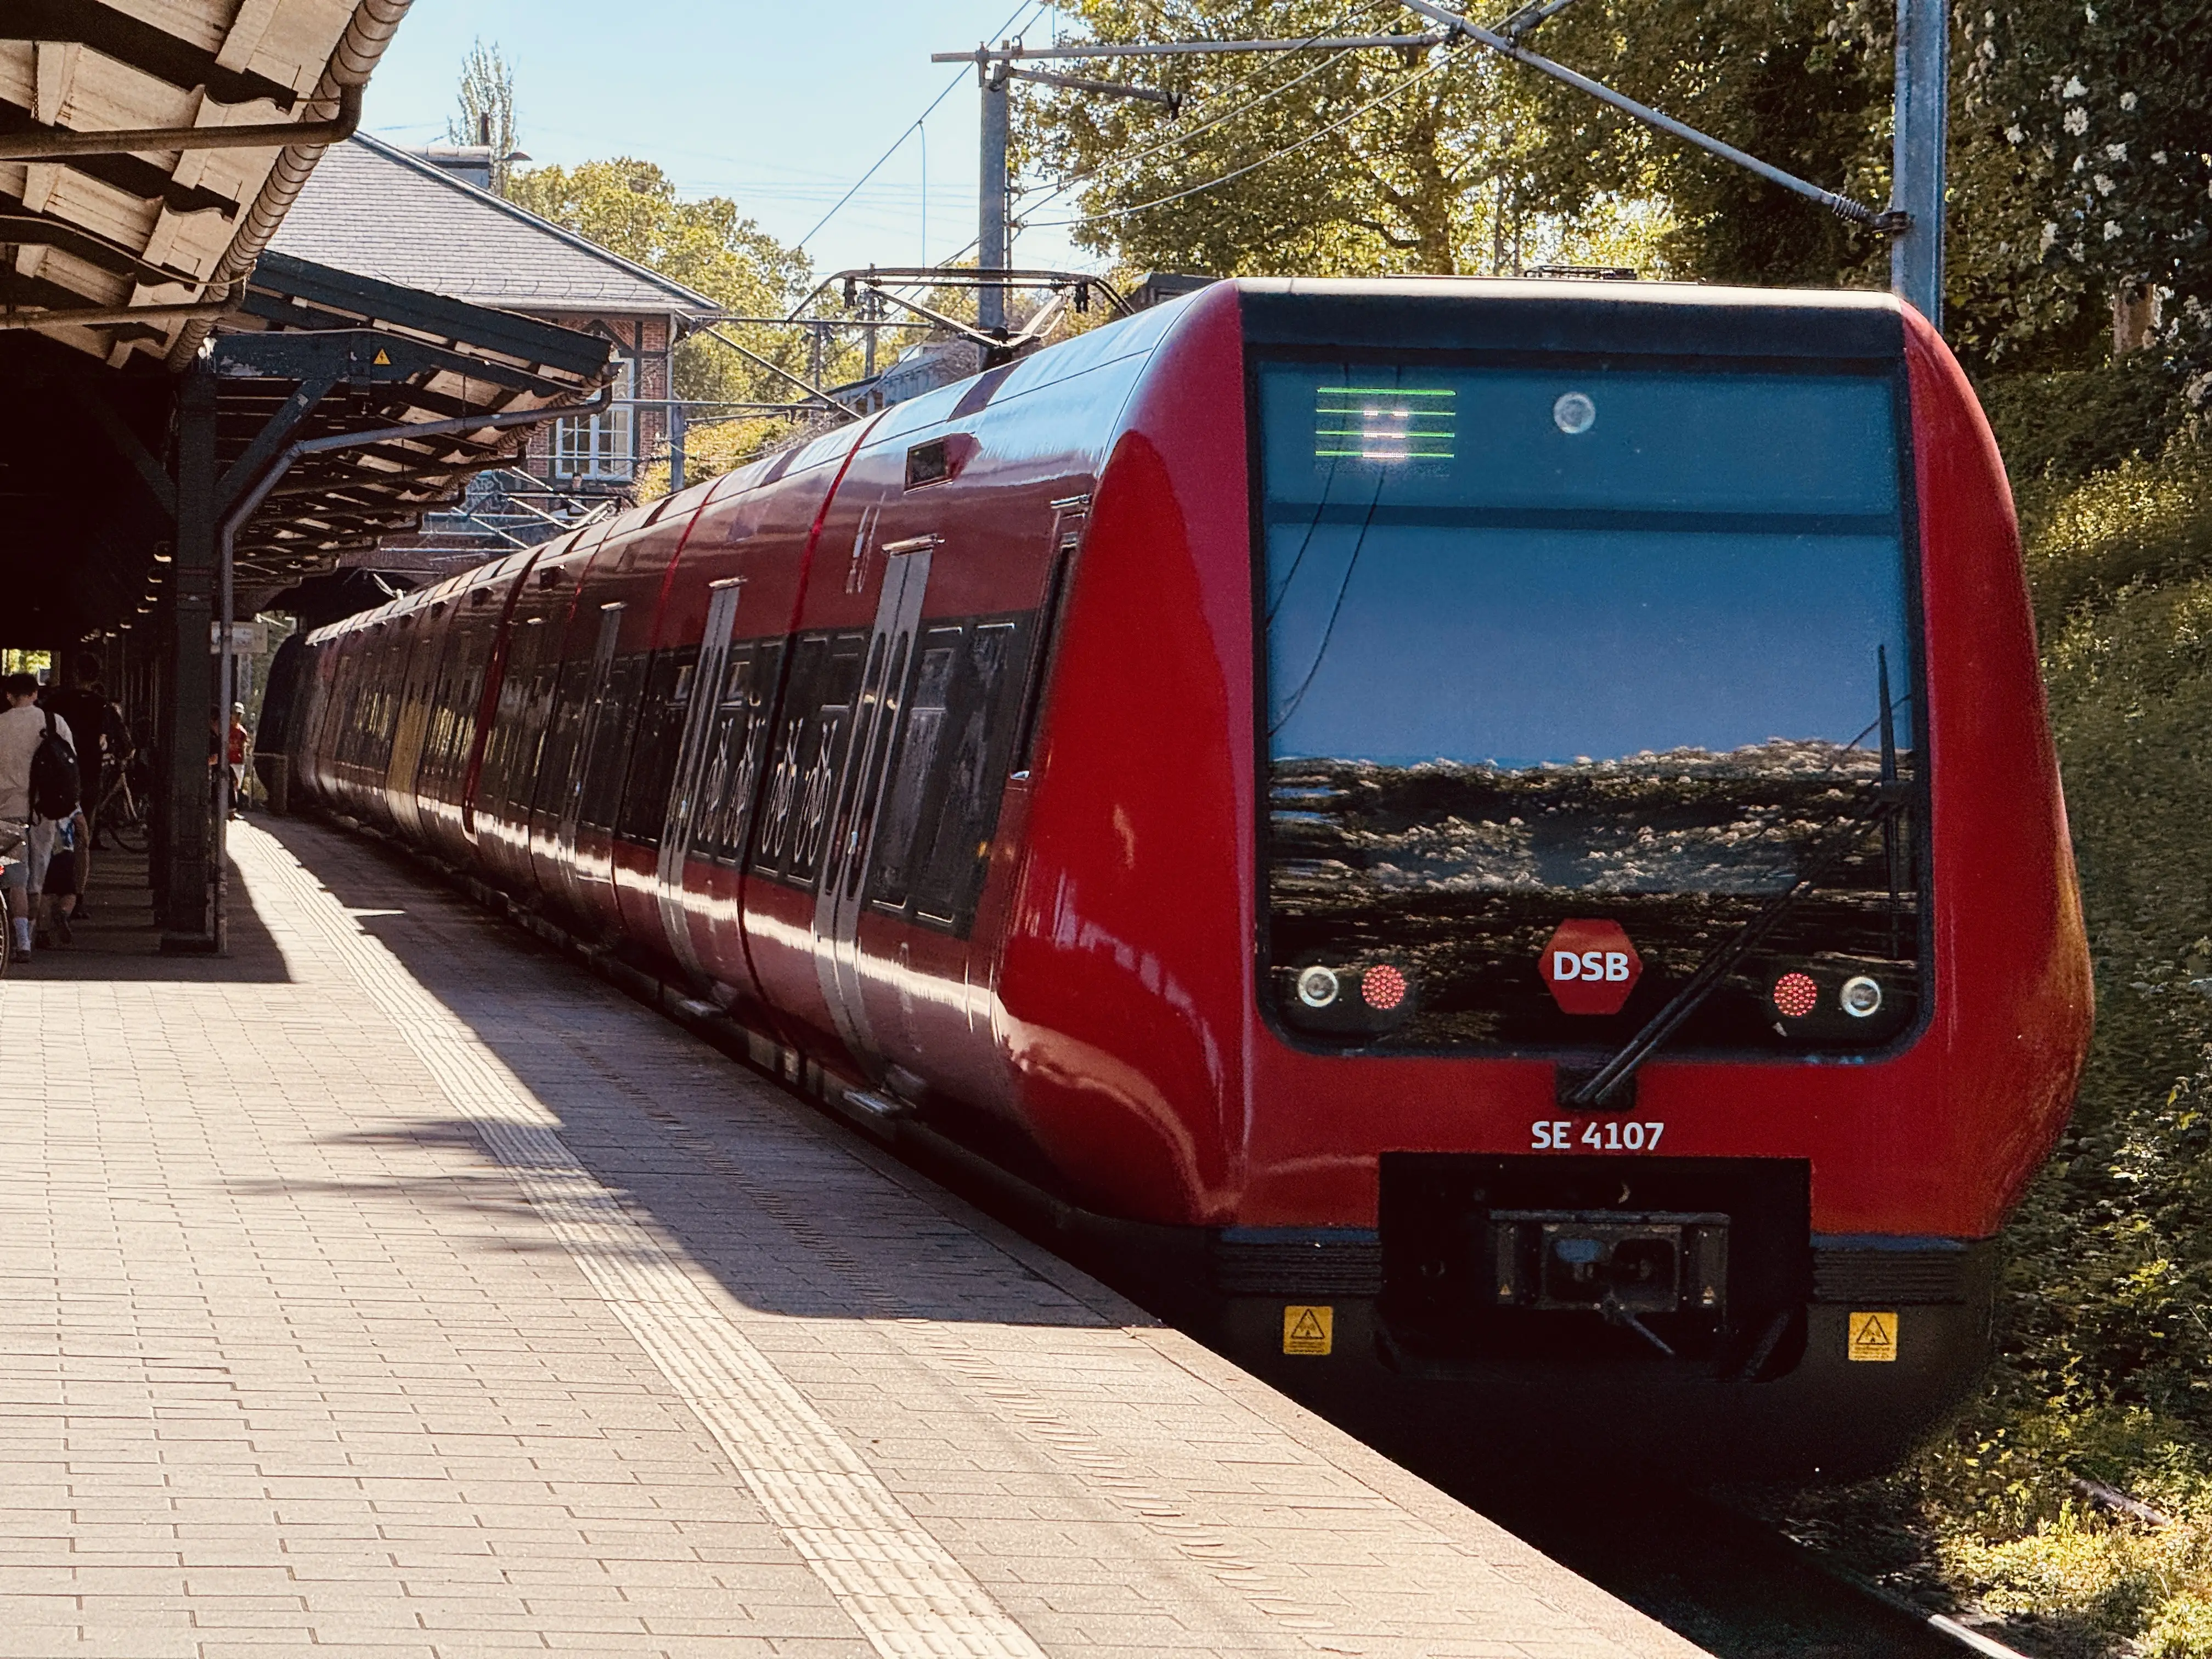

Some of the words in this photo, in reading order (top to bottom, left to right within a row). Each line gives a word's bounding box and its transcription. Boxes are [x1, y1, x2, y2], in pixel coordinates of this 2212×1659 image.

[1553, 951, 1629, 981] DSB
[1531, 1121, 1572, 1149] SE
[1581, 1122, 1664, 1150] 4107
